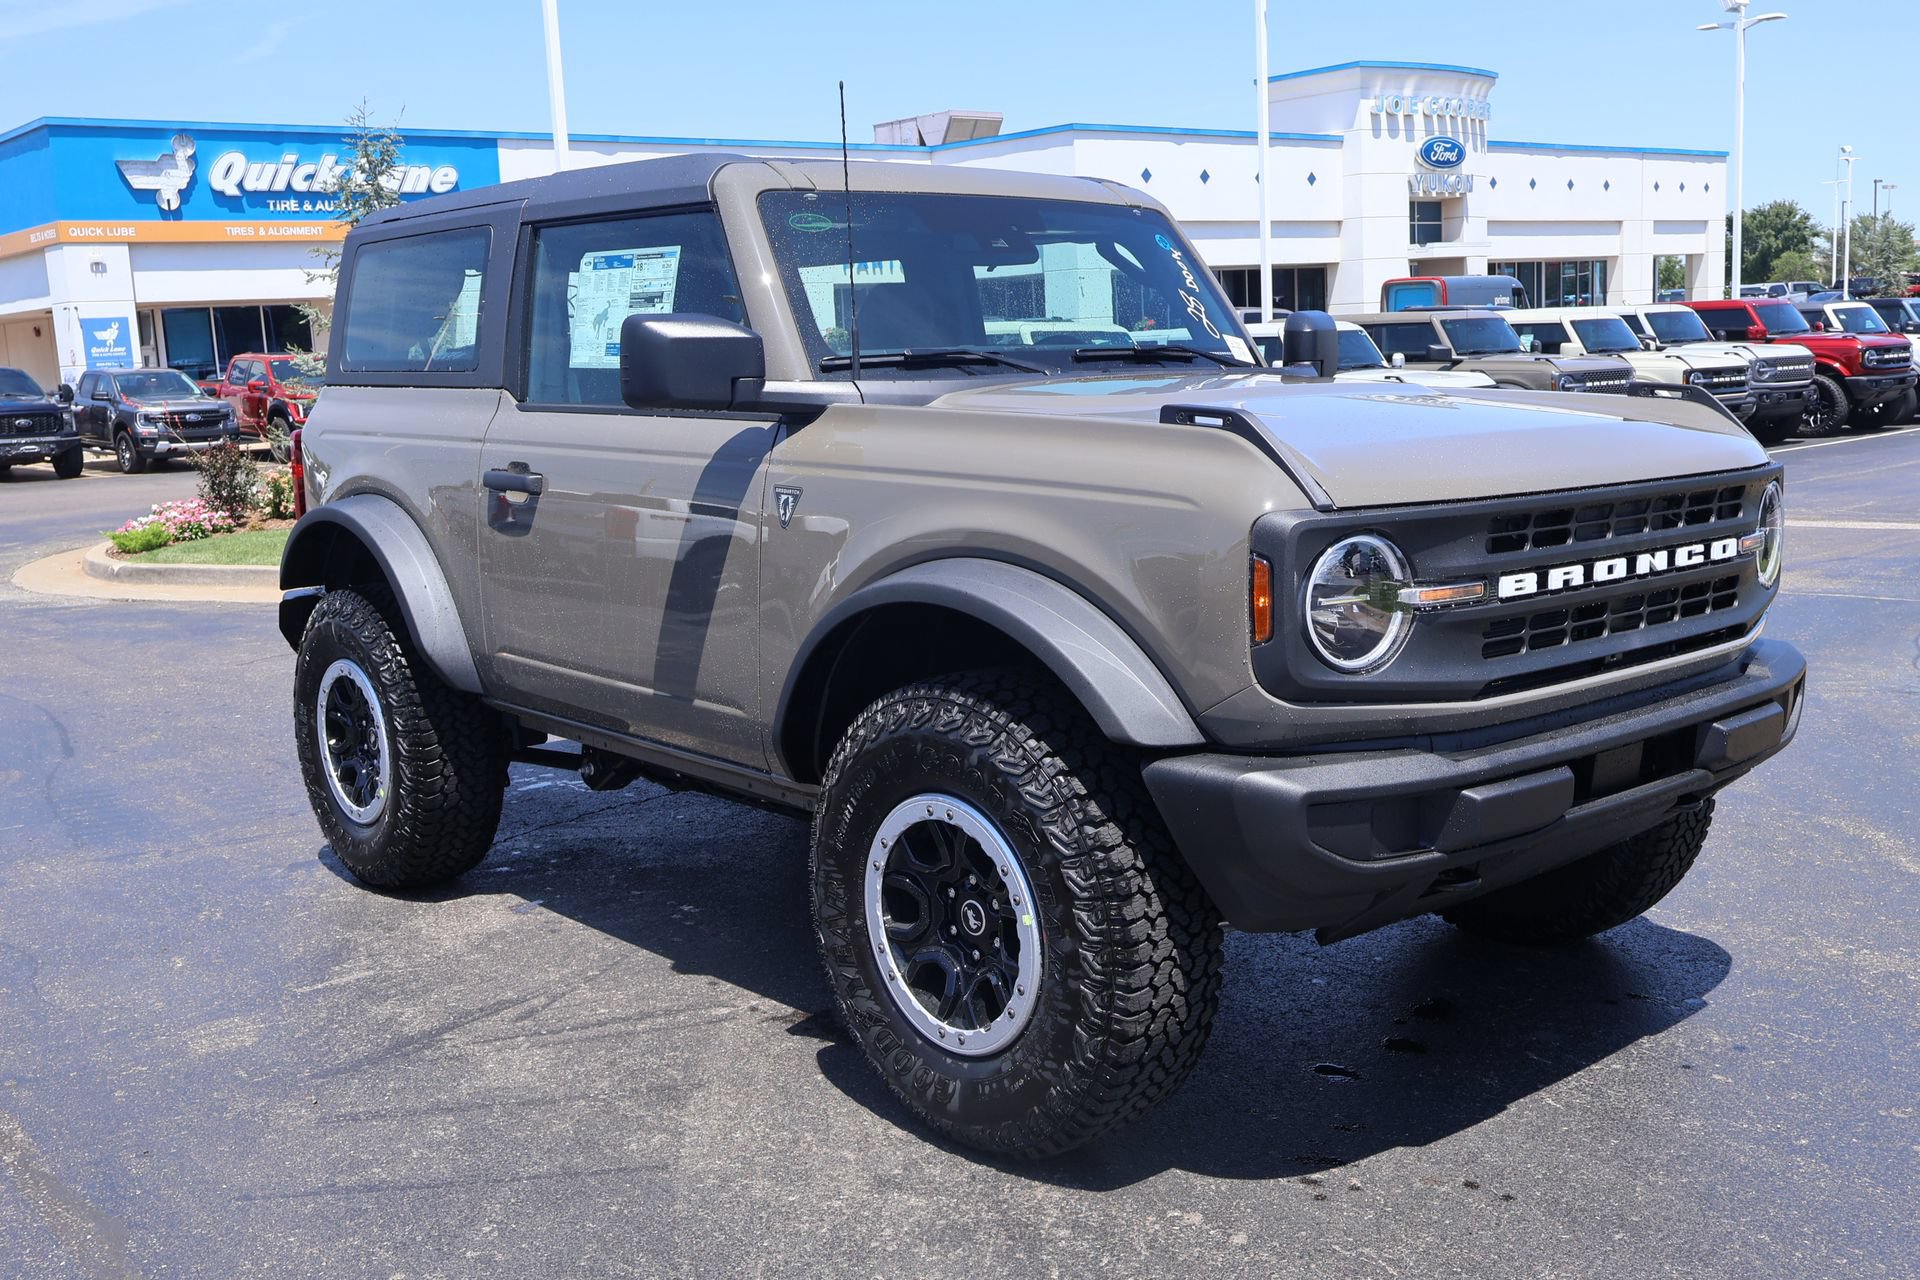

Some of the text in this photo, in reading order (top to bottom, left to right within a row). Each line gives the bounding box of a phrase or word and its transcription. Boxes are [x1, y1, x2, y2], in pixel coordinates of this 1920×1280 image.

[1375, 95, 1491, 120] JOE COOPER
[1430, 141, 1458, 162] Ford
[209, 151, 347, 197] Quick
[1414, 173, 1474, 193] YUKON
[266, 199, 300, 211] TIRE
[303, 199, 313, 211] &
[68, 226, 136, 237] QUICK LUBE
[224, 226, 323, 236] TIRES & ALIGNMENT
[1494, 294, 1510, 306] prime
[1498, 538, 1737, 599] BRONCO
